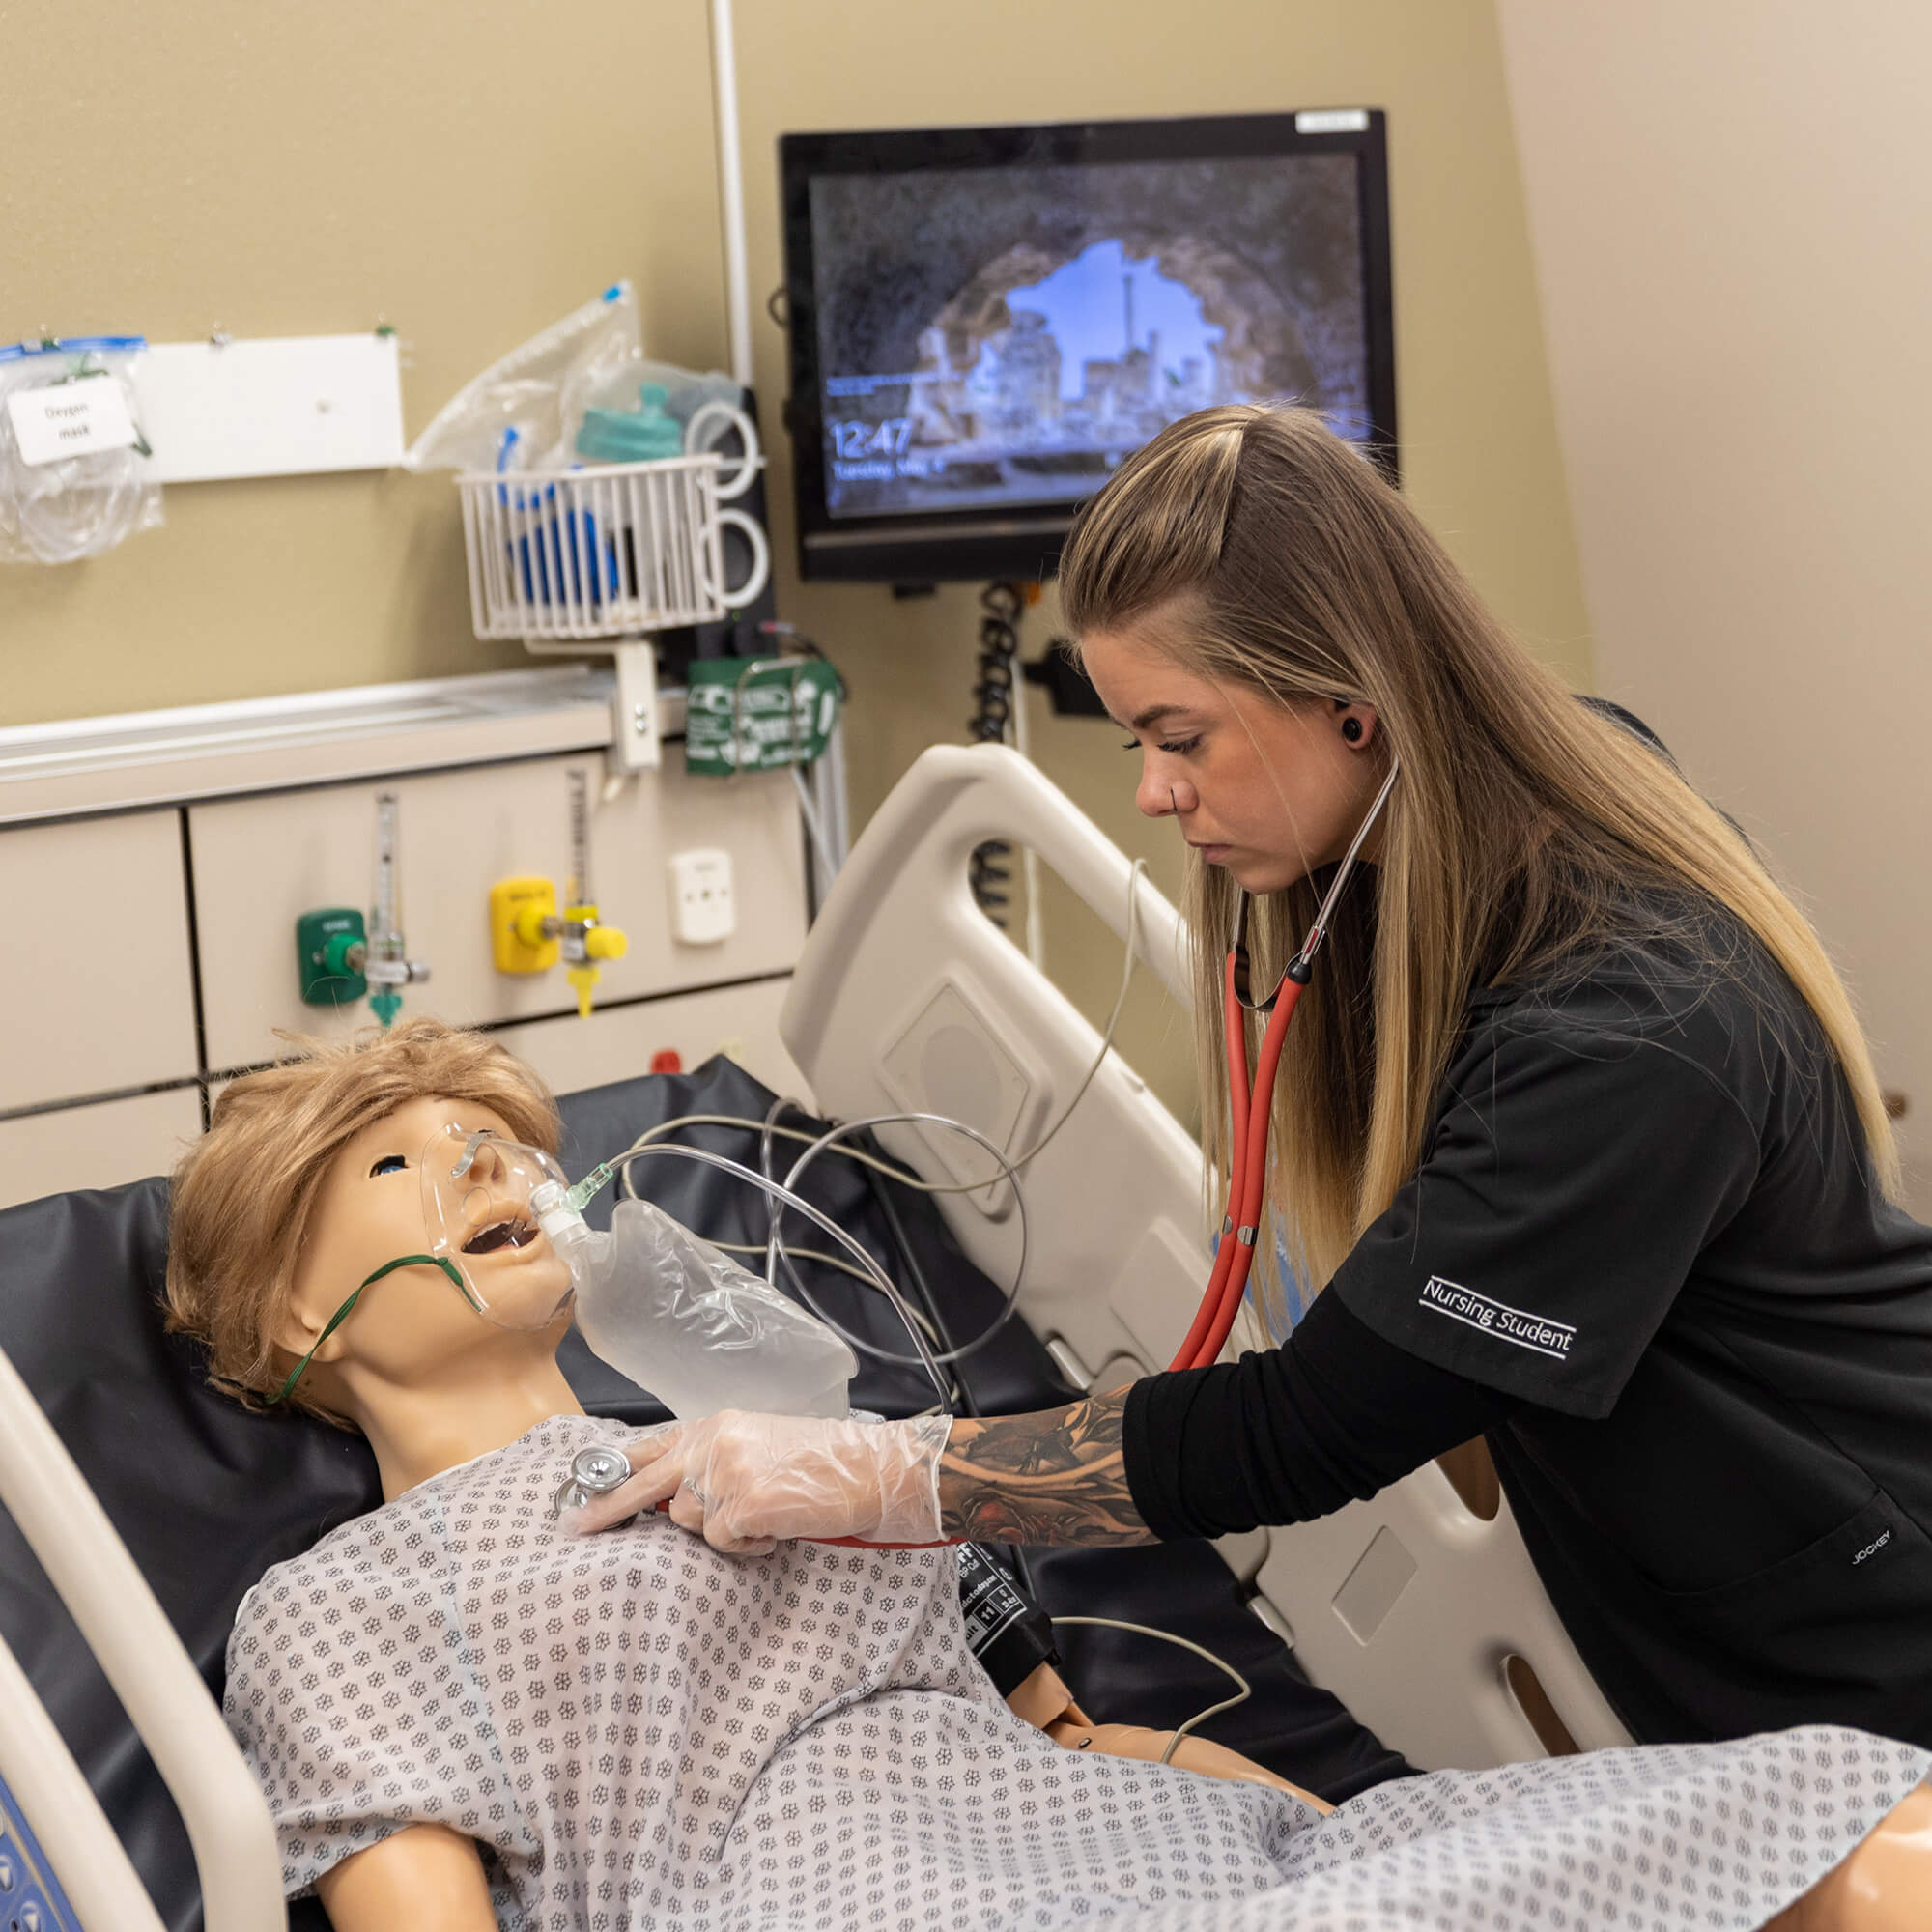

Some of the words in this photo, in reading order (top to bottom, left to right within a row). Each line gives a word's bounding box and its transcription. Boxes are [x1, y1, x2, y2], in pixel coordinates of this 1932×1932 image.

[44, 403, 89, 419] Oxygen
[58, 424, 90, 441] mask
[829, 417, 913, 459] 12:47
[1422, 1279, 1496, 1326] Nursing
[1496, 1311, 1574, 1351] Student
[1851, 1529, 1891, 1565] JOCKEY
[981, 1606, 995, 1620] 11
